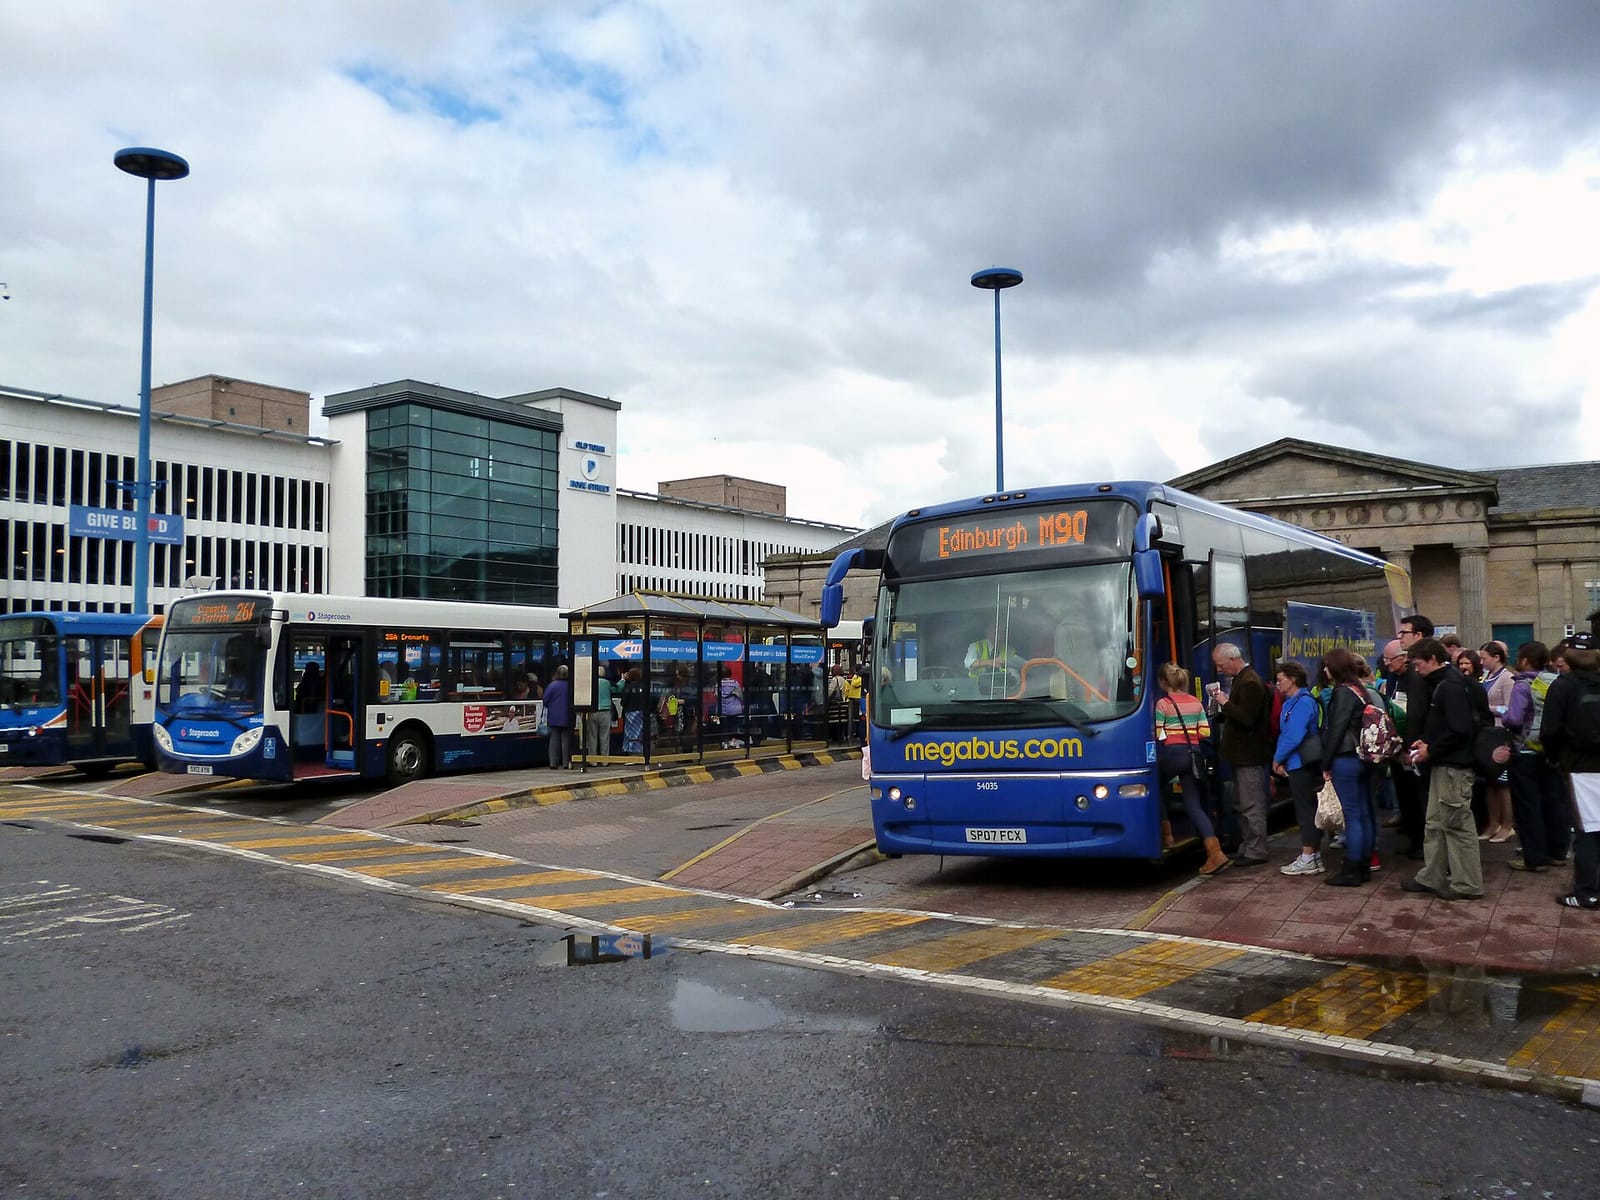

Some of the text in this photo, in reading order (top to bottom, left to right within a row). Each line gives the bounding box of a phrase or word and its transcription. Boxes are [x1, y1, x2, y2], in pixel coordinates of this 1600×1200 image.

[587, 460, 596, 474] P
[87, 512, 119, 529] GIVE
[122, 516, 168, 533] BLOD
[938, 509, 1088, 558] Edinburgh M90
[317, 612, 351, 621] Stagecoach
[581, 643, 587, 652] 5
[189, 728, 220, 739] Stagecoach
[904, 736, 1083, 767] megabus.com
[976, 781, 999, 791] 54035
[970, 830, 1022, 841] SP07 FCX
